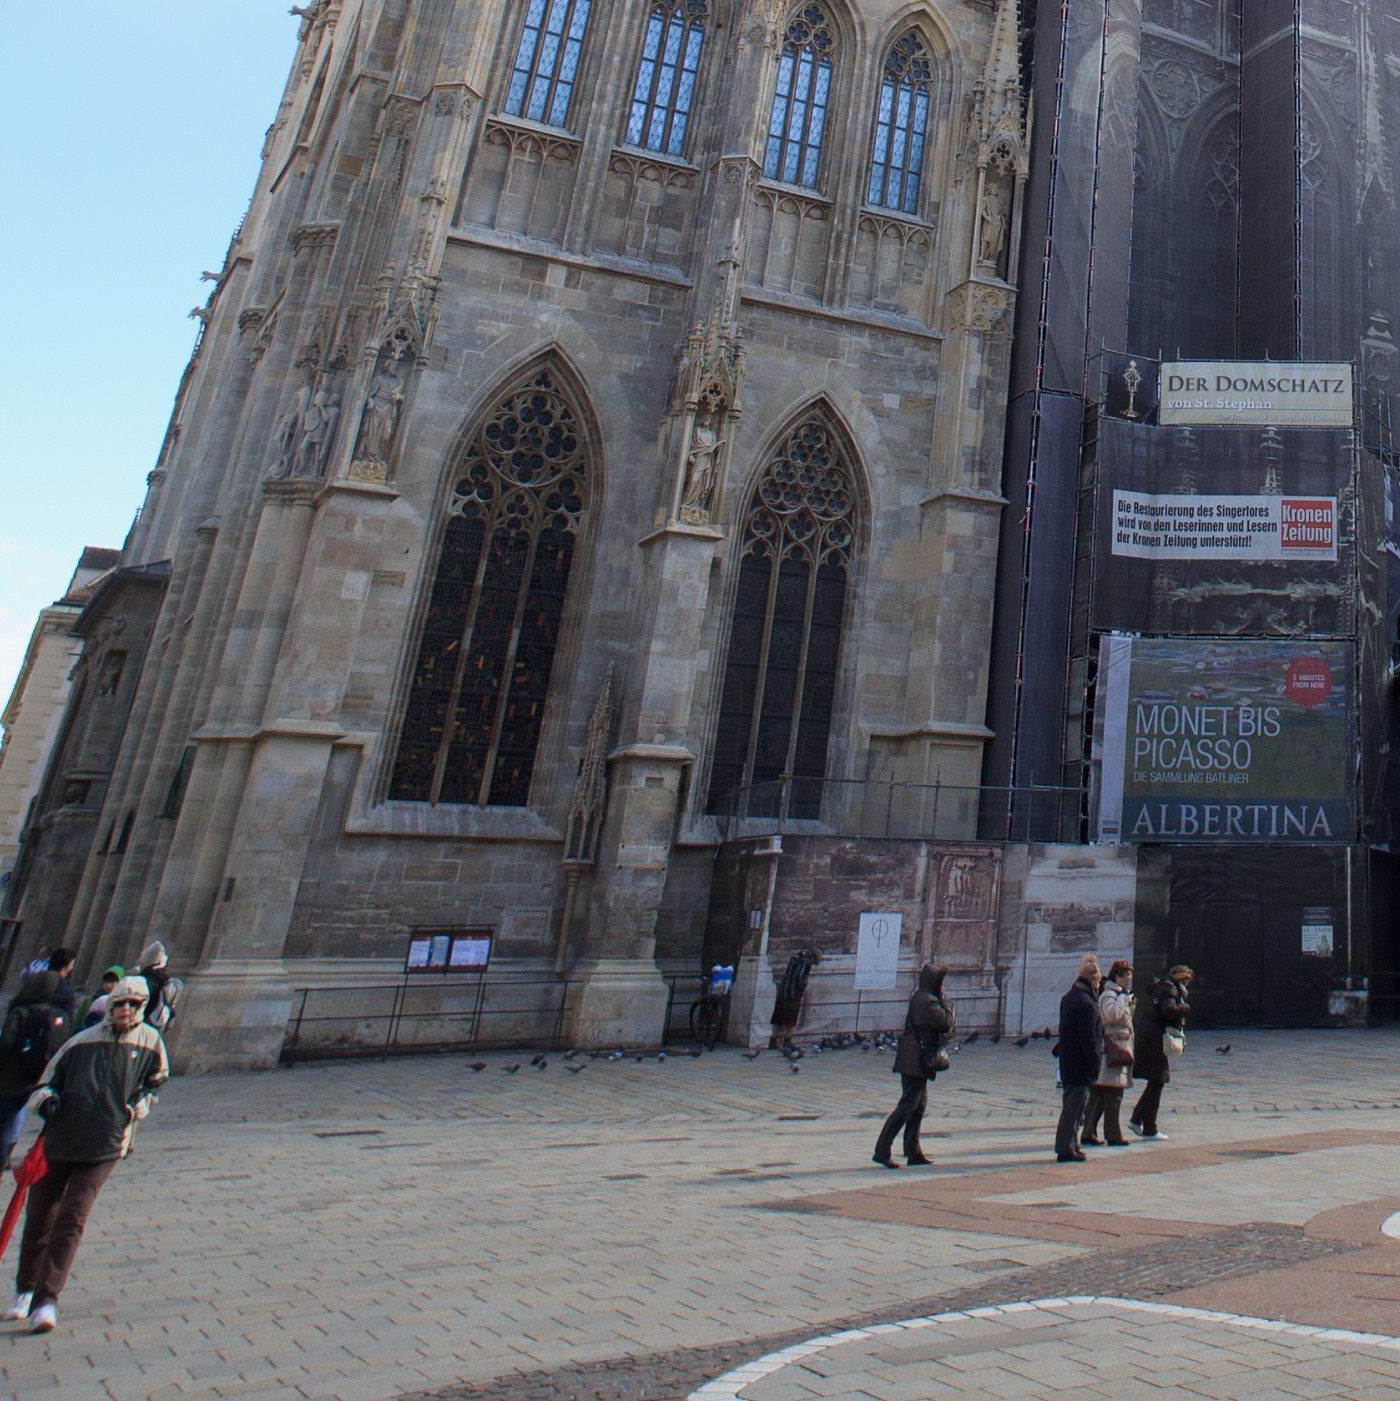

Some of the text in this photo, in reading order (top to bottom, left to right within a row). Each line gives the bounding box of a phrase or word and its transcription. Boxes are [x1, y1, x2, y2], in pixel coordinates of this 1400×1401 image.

[1168, 397, 1273, 412] von St. Stephan
[1117, 499, 1269, 519] Die Restaurierung des Singertores
[1281, 504, 1332, 523] Kronen
[1117, 515, 1278, 533] wird von den Leserinnen und Lesern
[1281, 524, 1332, 543] Zeitung
[1116, 530, 1252, 549] der Kronen Zeitung unterstützt!
[1135, 704, 1281, 737] MONET BIS
[1133, 737, 1251, 770] PICASSO
[1133, 771, 1249, 784] DIE SAMMLUNG BATLINER
[1130, 803, 1334, 837] ALBERTINA
